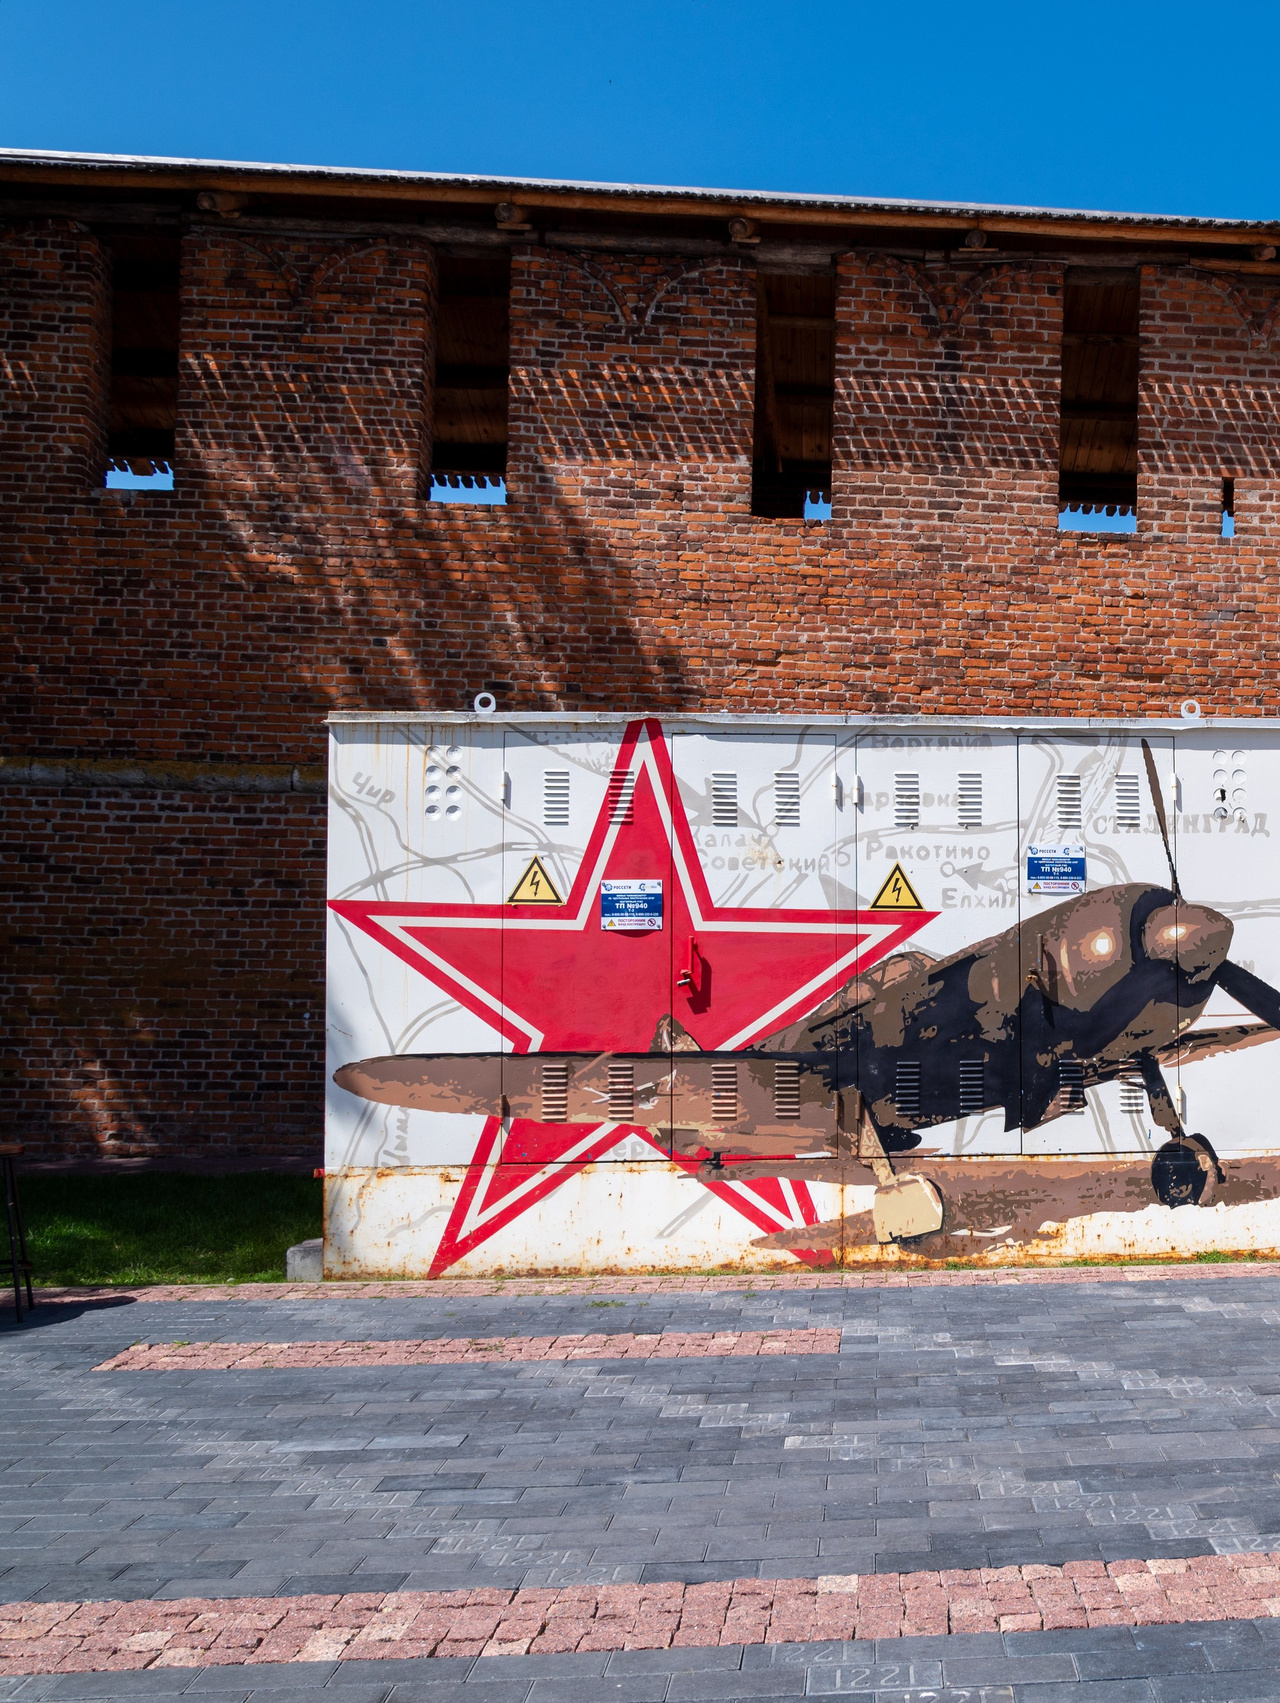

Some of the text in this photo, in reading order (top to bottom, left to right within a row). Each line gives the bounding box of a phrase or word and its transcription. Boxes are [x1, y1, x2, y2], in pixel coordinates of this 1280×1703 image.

[1000, 1482, 1061, 1496] 1221
[1053, 1494, 1116, 1510] 1221
[1110, 1506, 1175, 1523] 1221
[412, 1520, 482, 1535] 1221
[1169, 1518, 1237, 1536] 1221
[453, 1536, 524, 1551] 1221
[499, 1550, 571, 1567] 1221
[547, 1565, 622, 1583] 1221
[770, 1644, 848, 1663] 1221
[835, 1665, 915, 1688] 1221
